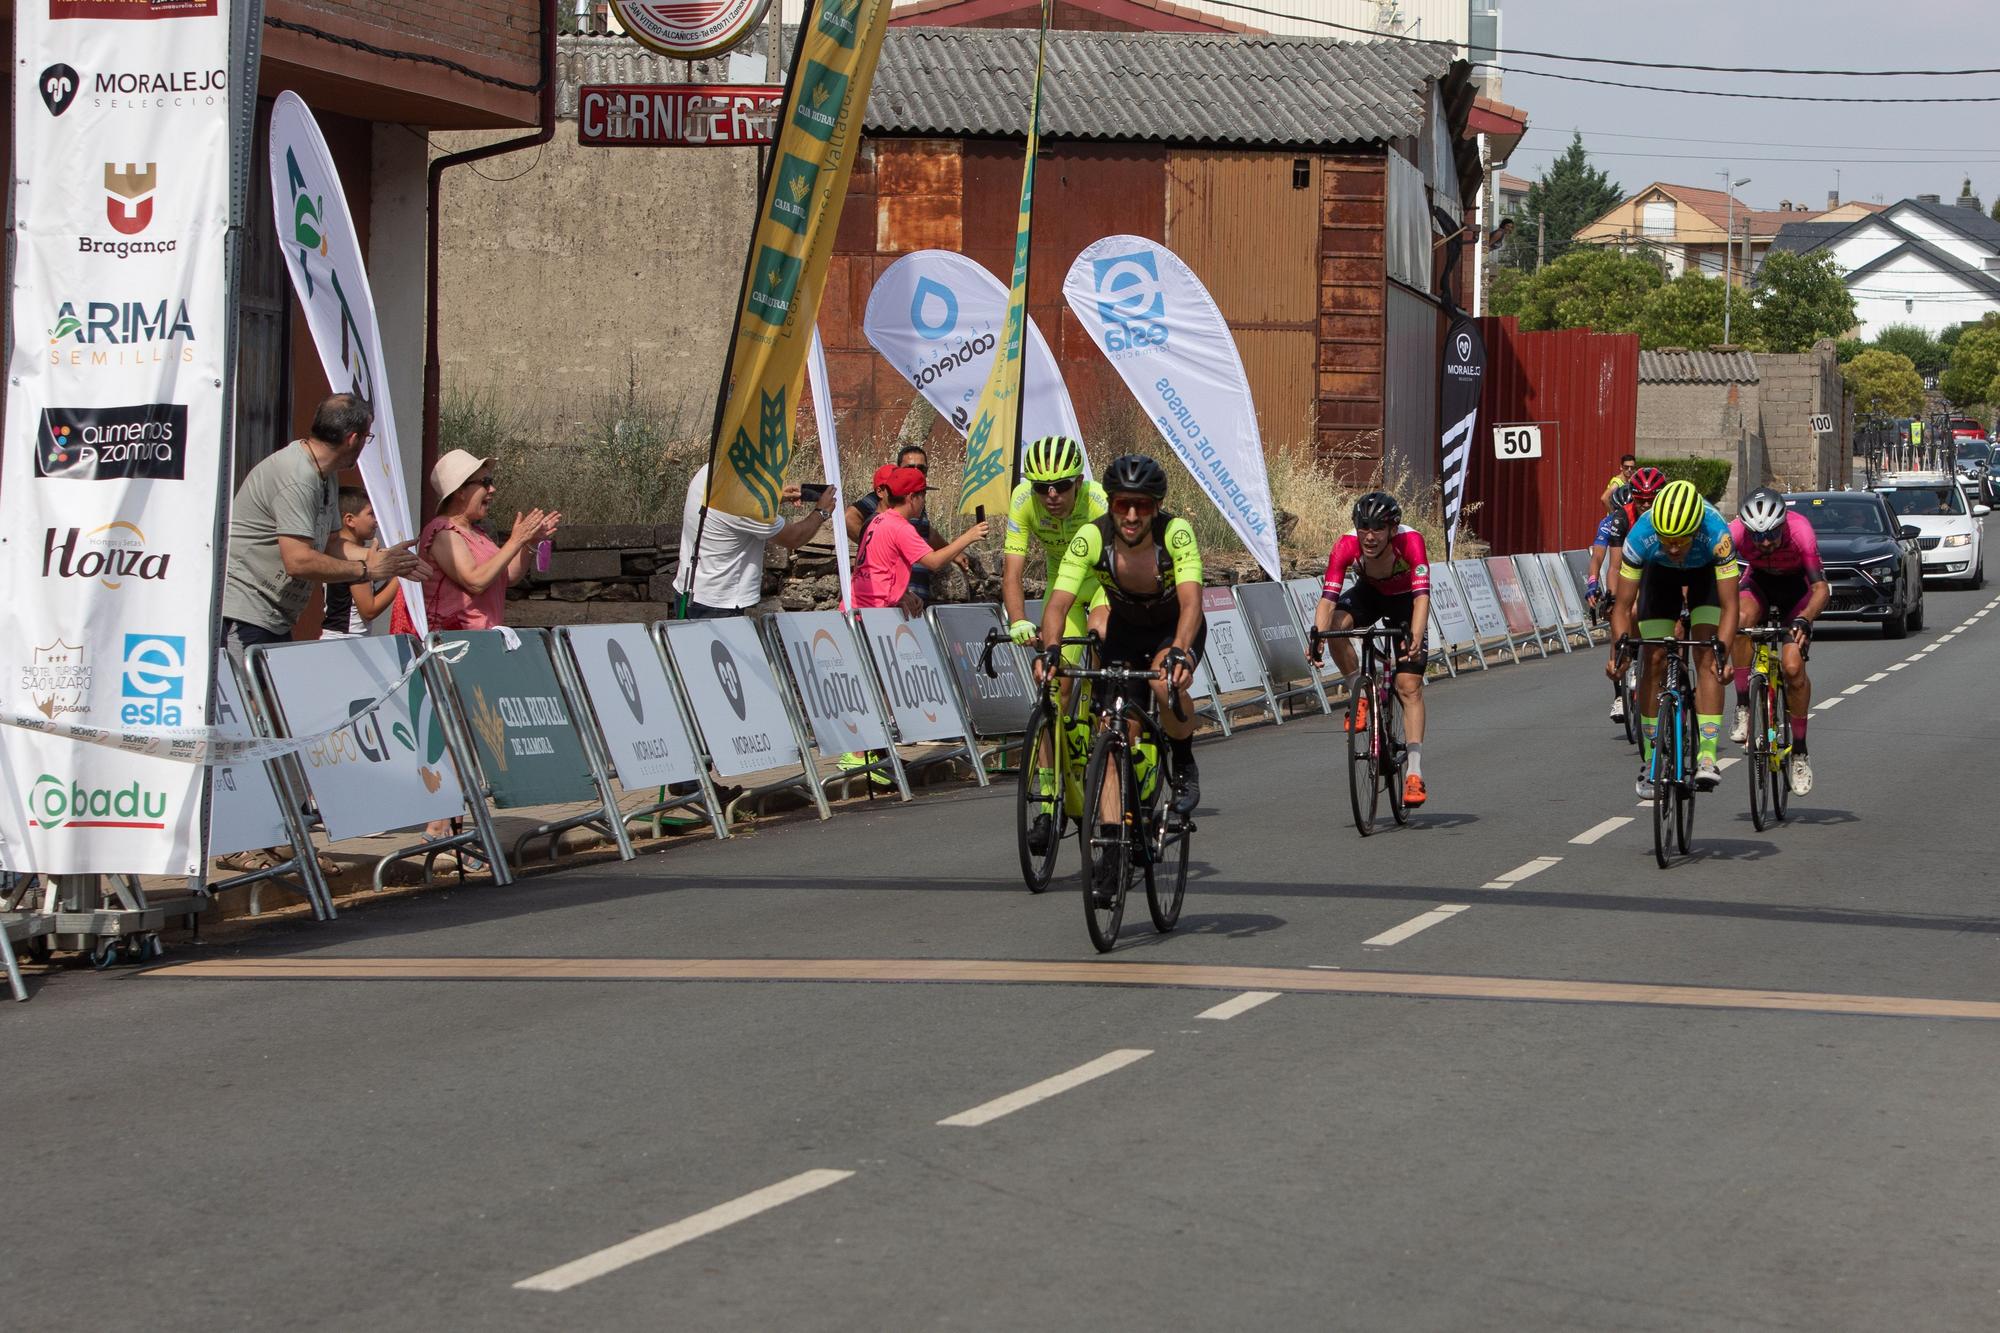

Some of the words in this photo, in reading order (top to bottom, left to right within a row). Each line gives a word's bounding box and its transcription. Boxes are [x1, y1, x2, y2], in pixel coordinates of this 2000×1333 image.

[629, 2, 642, 18] SAN
[95, 69, 226, 94] MORALEJO
[79, 236, 176, 259] Bragança
[1810, 416, 1831, 432] 100
[1504, 430, 1531, 454] 50
[121, 697, 182, 726] esla
[499, 697, 532, 729] CAJA
[525, 697, 568, 726] RURAL
[511, 738, 525, 755] DE
[522, 737, 555, 755] ZAMORA
[632, 738, 669, 761] MORALEJO
[732, 733, 771, 755] MORALEJO
